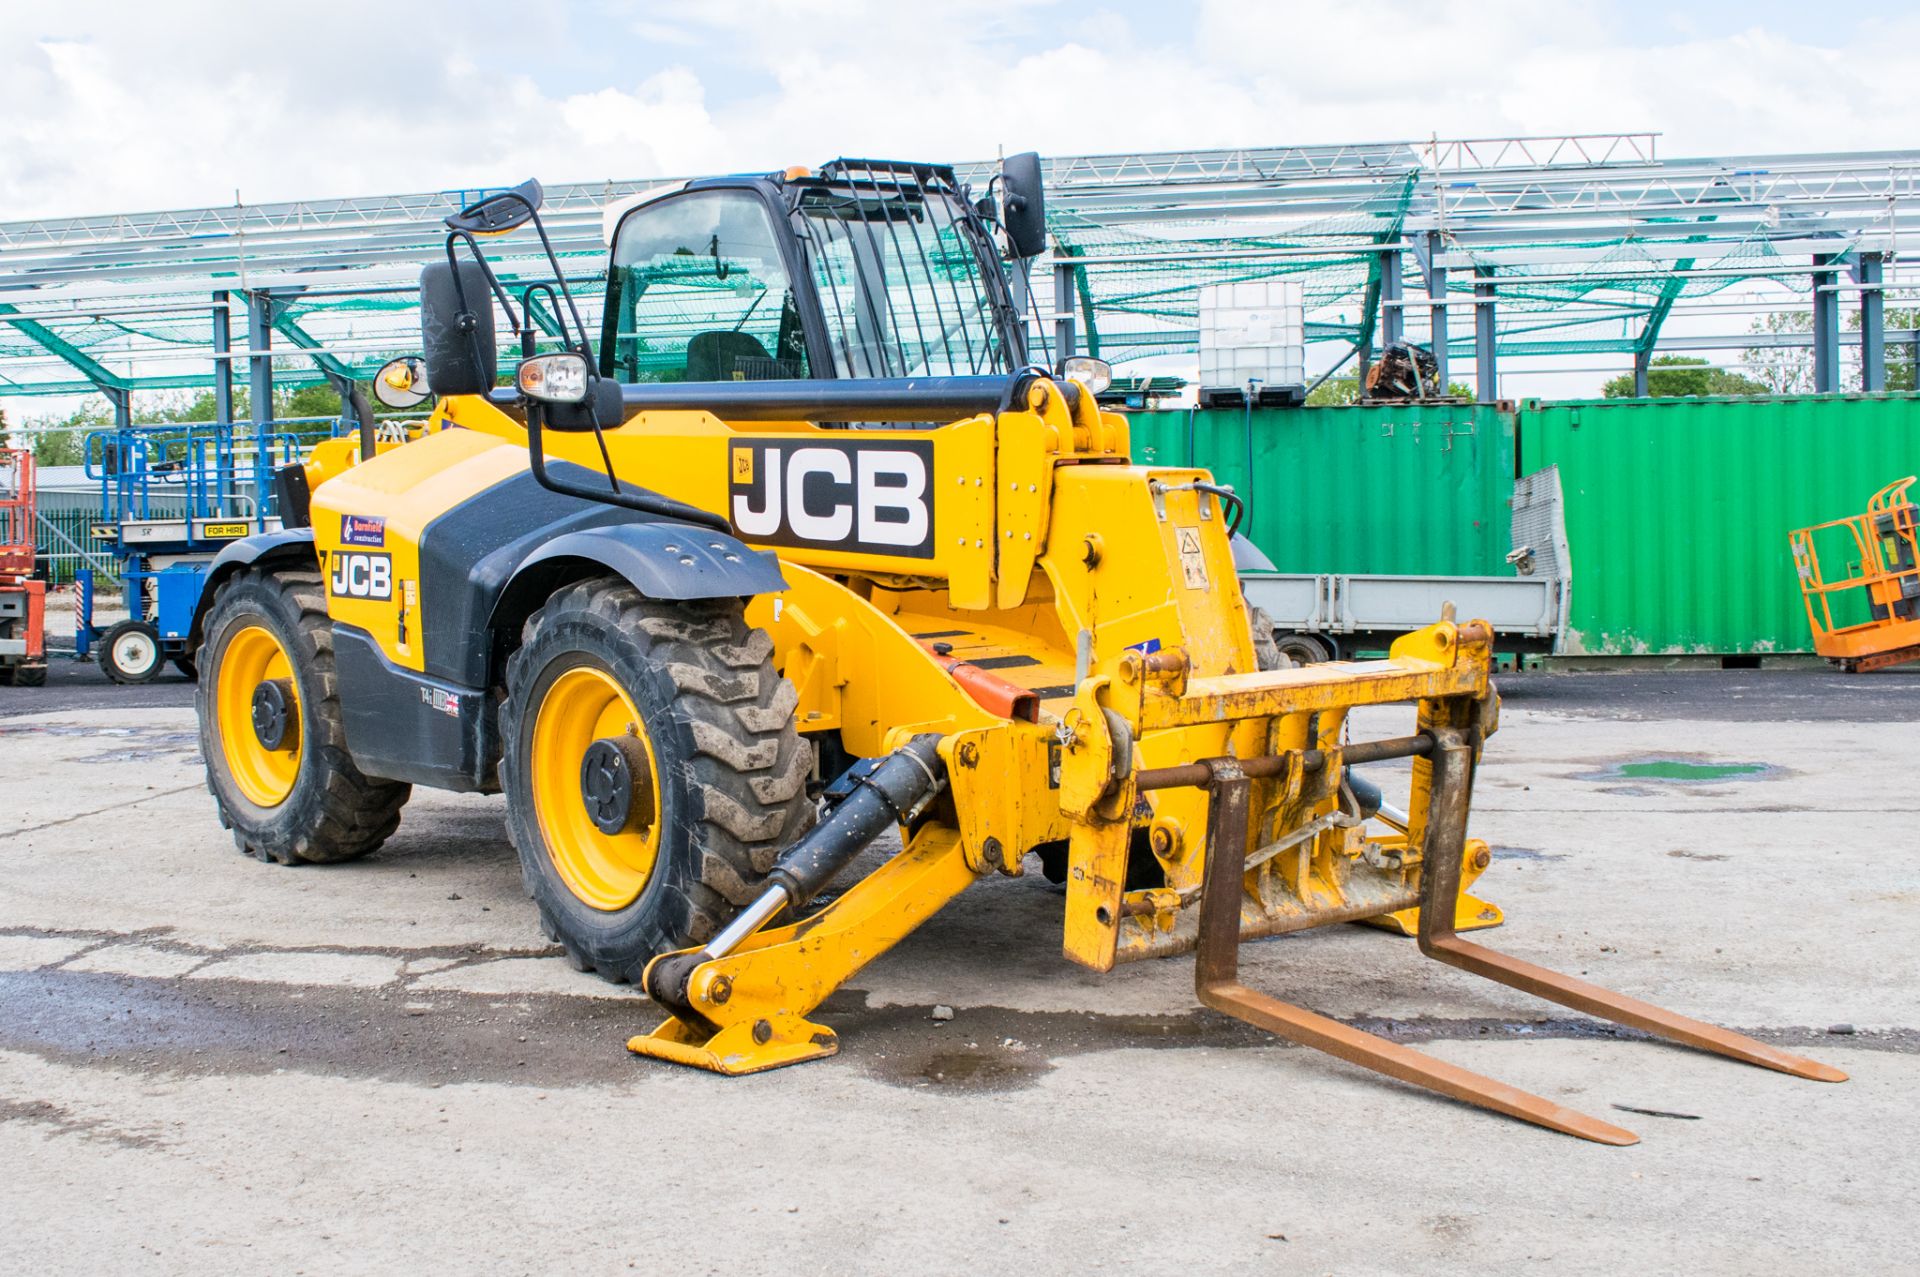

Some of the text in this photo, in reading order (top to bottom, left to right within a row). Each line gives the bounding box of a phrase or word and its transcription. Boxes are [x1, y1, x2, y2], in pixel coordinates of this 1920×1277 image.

[733, 448, 929, 546] JCB
[207, 526, 245, 535] FOR HIRE
[353, 534, 382, 544] construction
[332, 554, 391, 598] JCB
